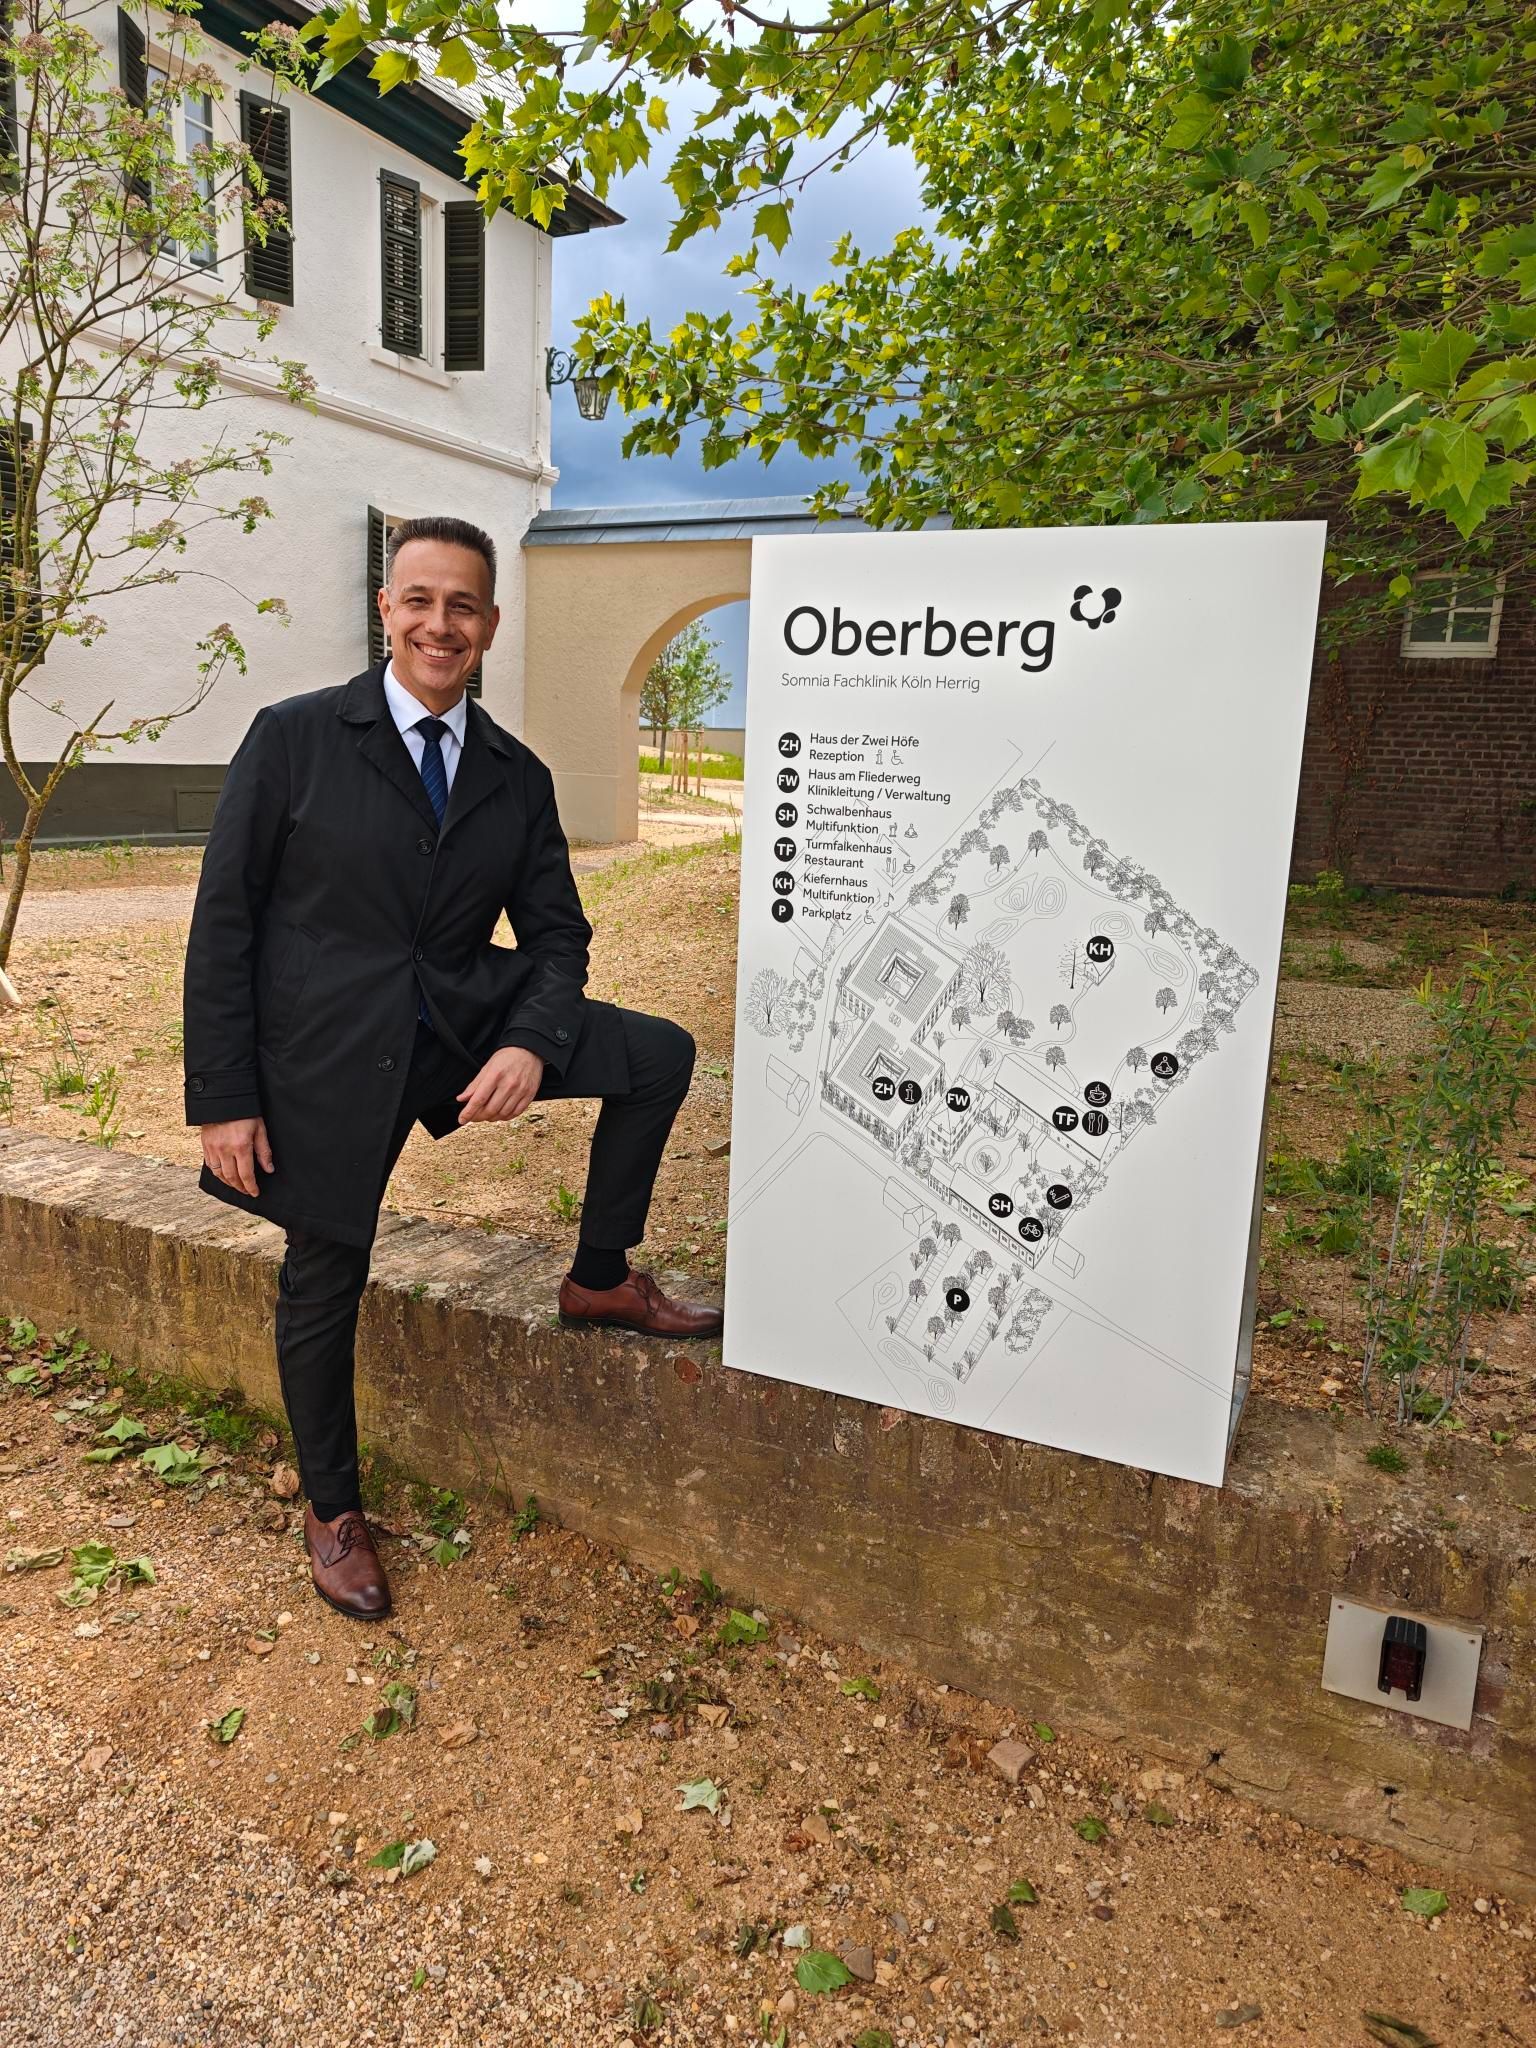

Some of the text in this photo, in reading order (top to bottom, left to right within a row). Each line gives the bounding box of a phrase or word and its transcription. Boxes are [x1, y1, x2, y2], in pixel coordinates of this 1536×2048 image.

[784, 606, 1055, 673] Oberberg
[781, 673, 981, 693] Somnia Fachklinik Köln Herrig
[780, 739, 799, 751] ZH
[810, 733, 920, 748] Haus der Zwei Höfe
[809, 750, 865, 763] Rezeption
[778, 774, 799, 787] FW
[808, 769, 921, 787] Haus am Fliederweg
[807, 785, 951, 805] Klinikleitung / Verwaltung
[777, 809, 796, 822] SH
[806, 804, 892, 819] Schwalbenhaus
[806, 820, 879, 834] Multifunktion
[776, 843, 795, 856] TF
[805, 838, 892, 854] Turmfalkenhaus
[804, 854, 864, 868] Restaurant
[774, 878, 793, 890] KH
[803, 873, 868, 887] Kiefernhaus
[802, 888, 875, 904] Multifunktion
[802, 907, 852, 921] Parkplatz
[1089, 942, 1112, 957] KH
[874, 1082, 894, 1096] ZH
[947, 1093, 969, 1107] FW
[1055, 1112, 1077, 1126] TF
[991, 1199, 1011, 1212] SH
